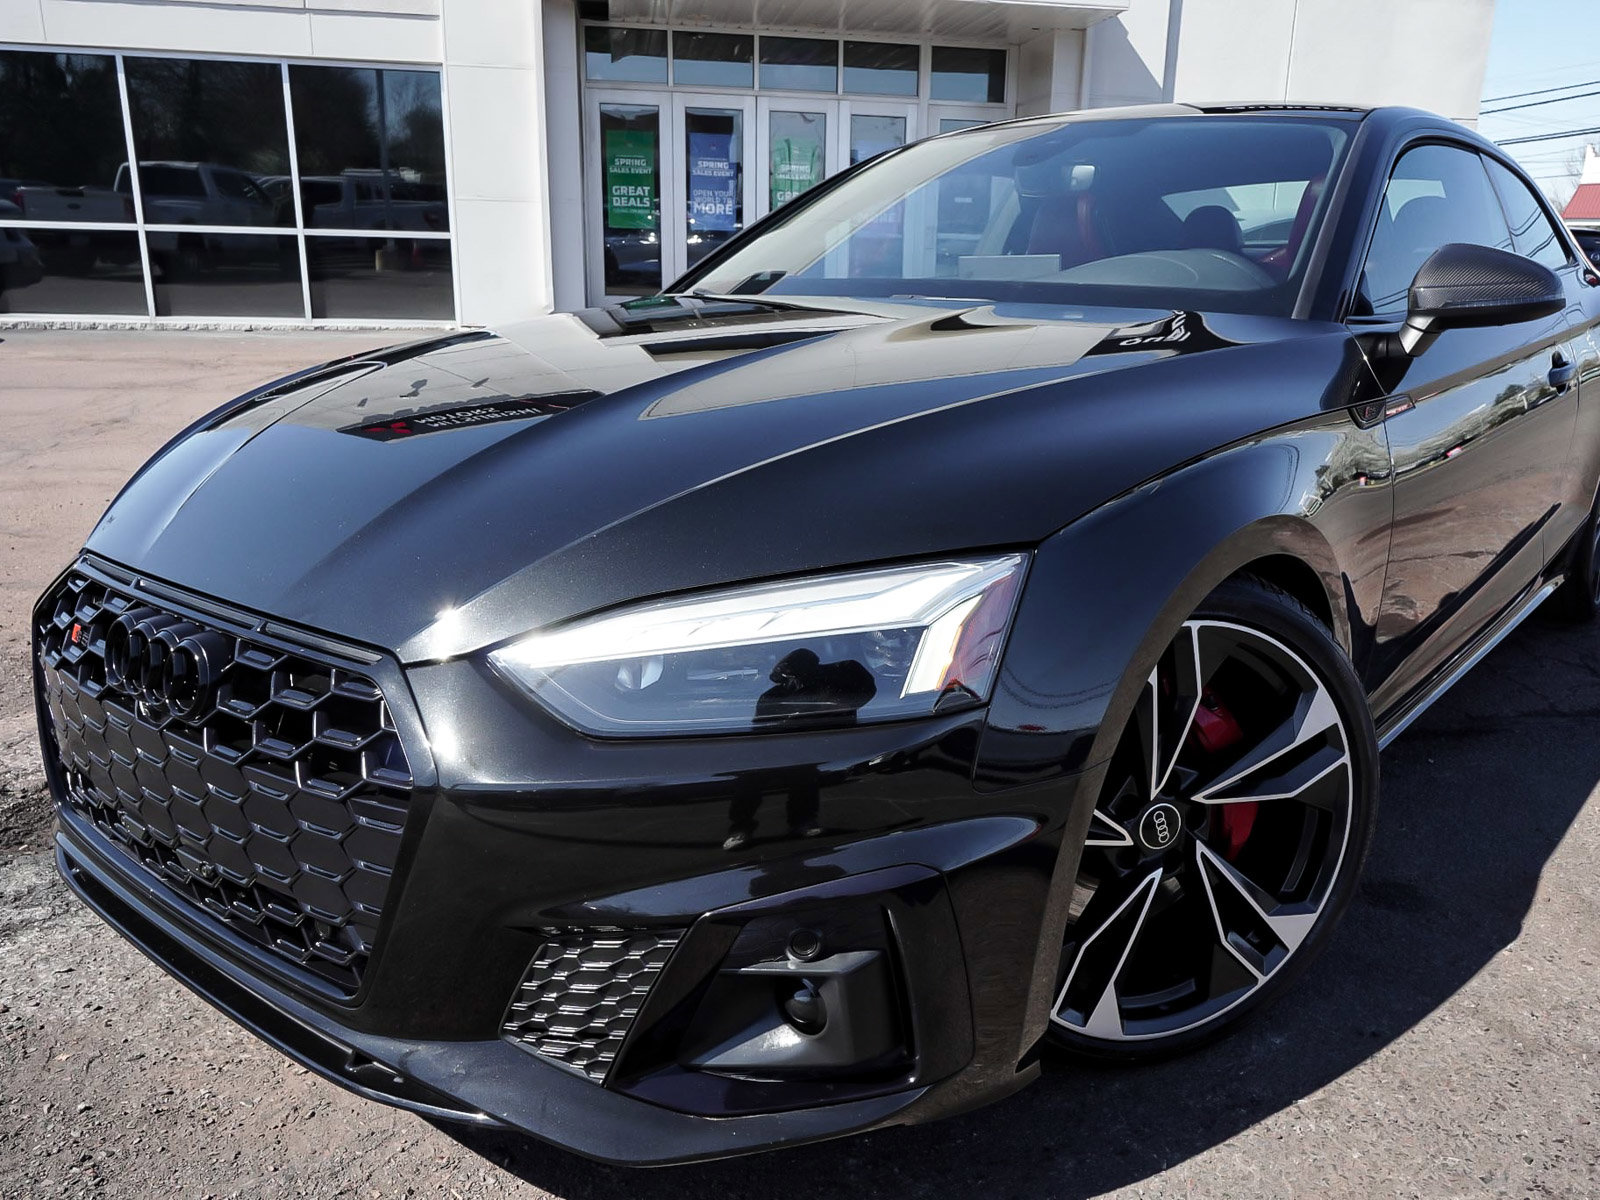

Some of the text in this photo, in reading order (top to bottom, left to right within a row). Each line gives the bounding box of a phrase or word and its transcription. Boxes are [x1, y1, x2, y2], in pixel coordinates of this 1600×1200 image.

[614, 158, 647, 166] SPRING
[697, 161, 730, 169] SPRING
[612, 185, 650, 196] GREAT
[693, 189, 713, 197] OPEN
[612, 196, 650, 208] DEALS
[693, 203, 733, 215] MORE
